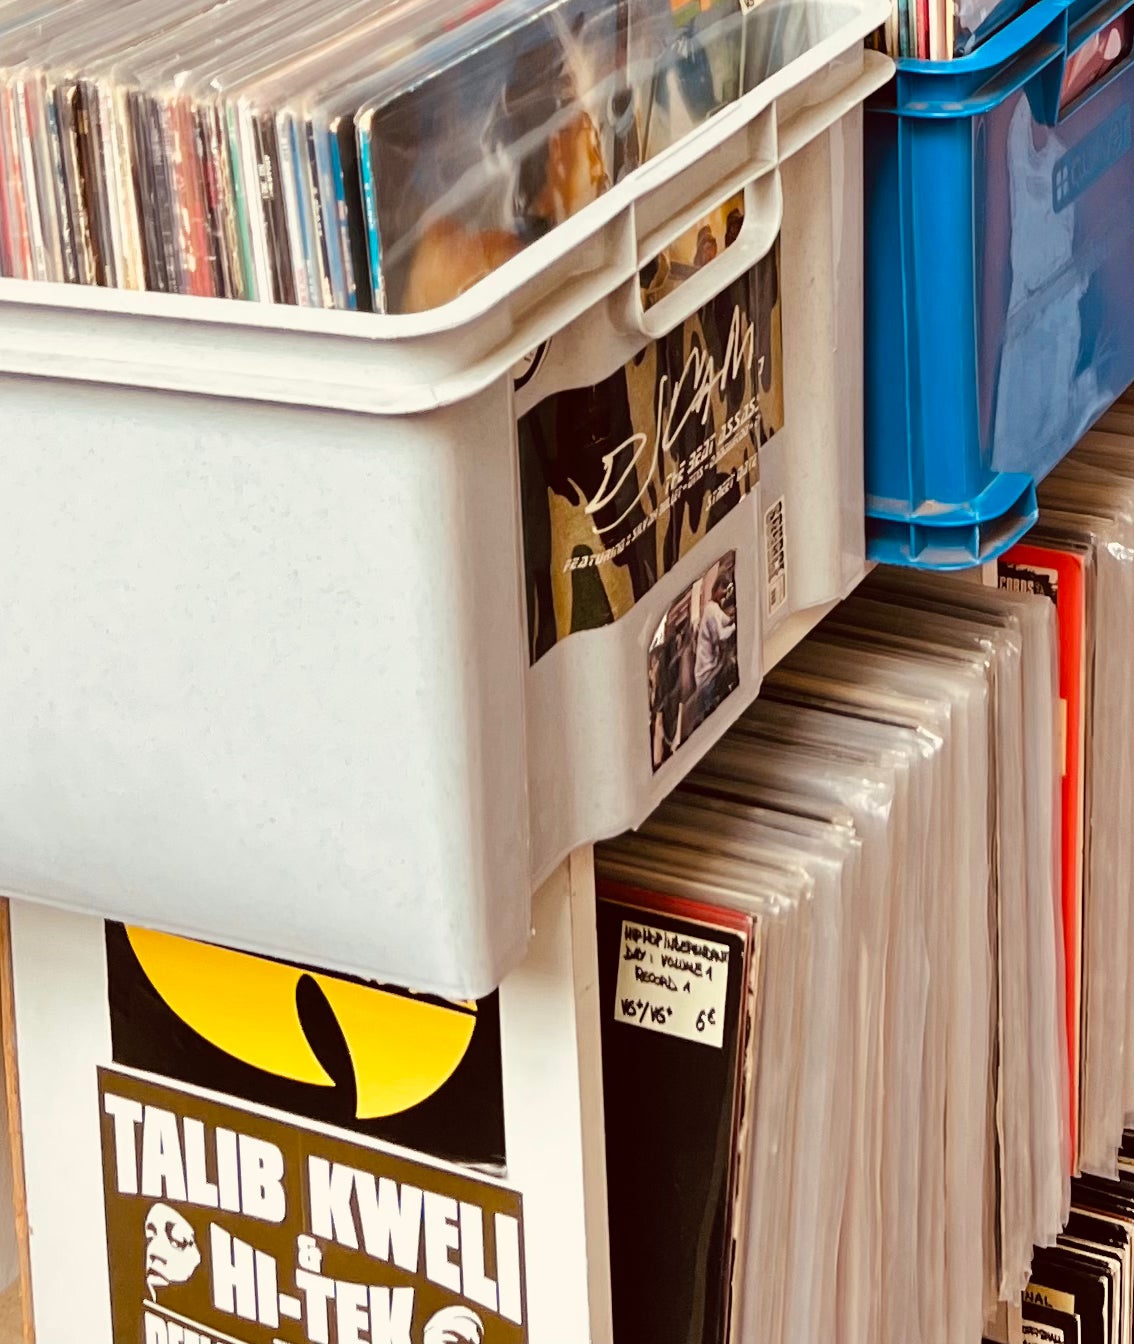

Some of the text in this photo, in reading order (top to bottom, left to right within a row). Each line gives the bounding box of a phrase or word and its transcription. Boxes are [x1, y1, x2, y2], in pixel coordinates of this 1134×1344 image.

[635, 966, 678, 993] RECORD
[661, 954, 702, 978] VOLUME
[104, 1092, 522, 1326] TALIB KWELI
[298, 1234, 322, 1273] &
[210, 1222, 415, 1344] HI-TEK
